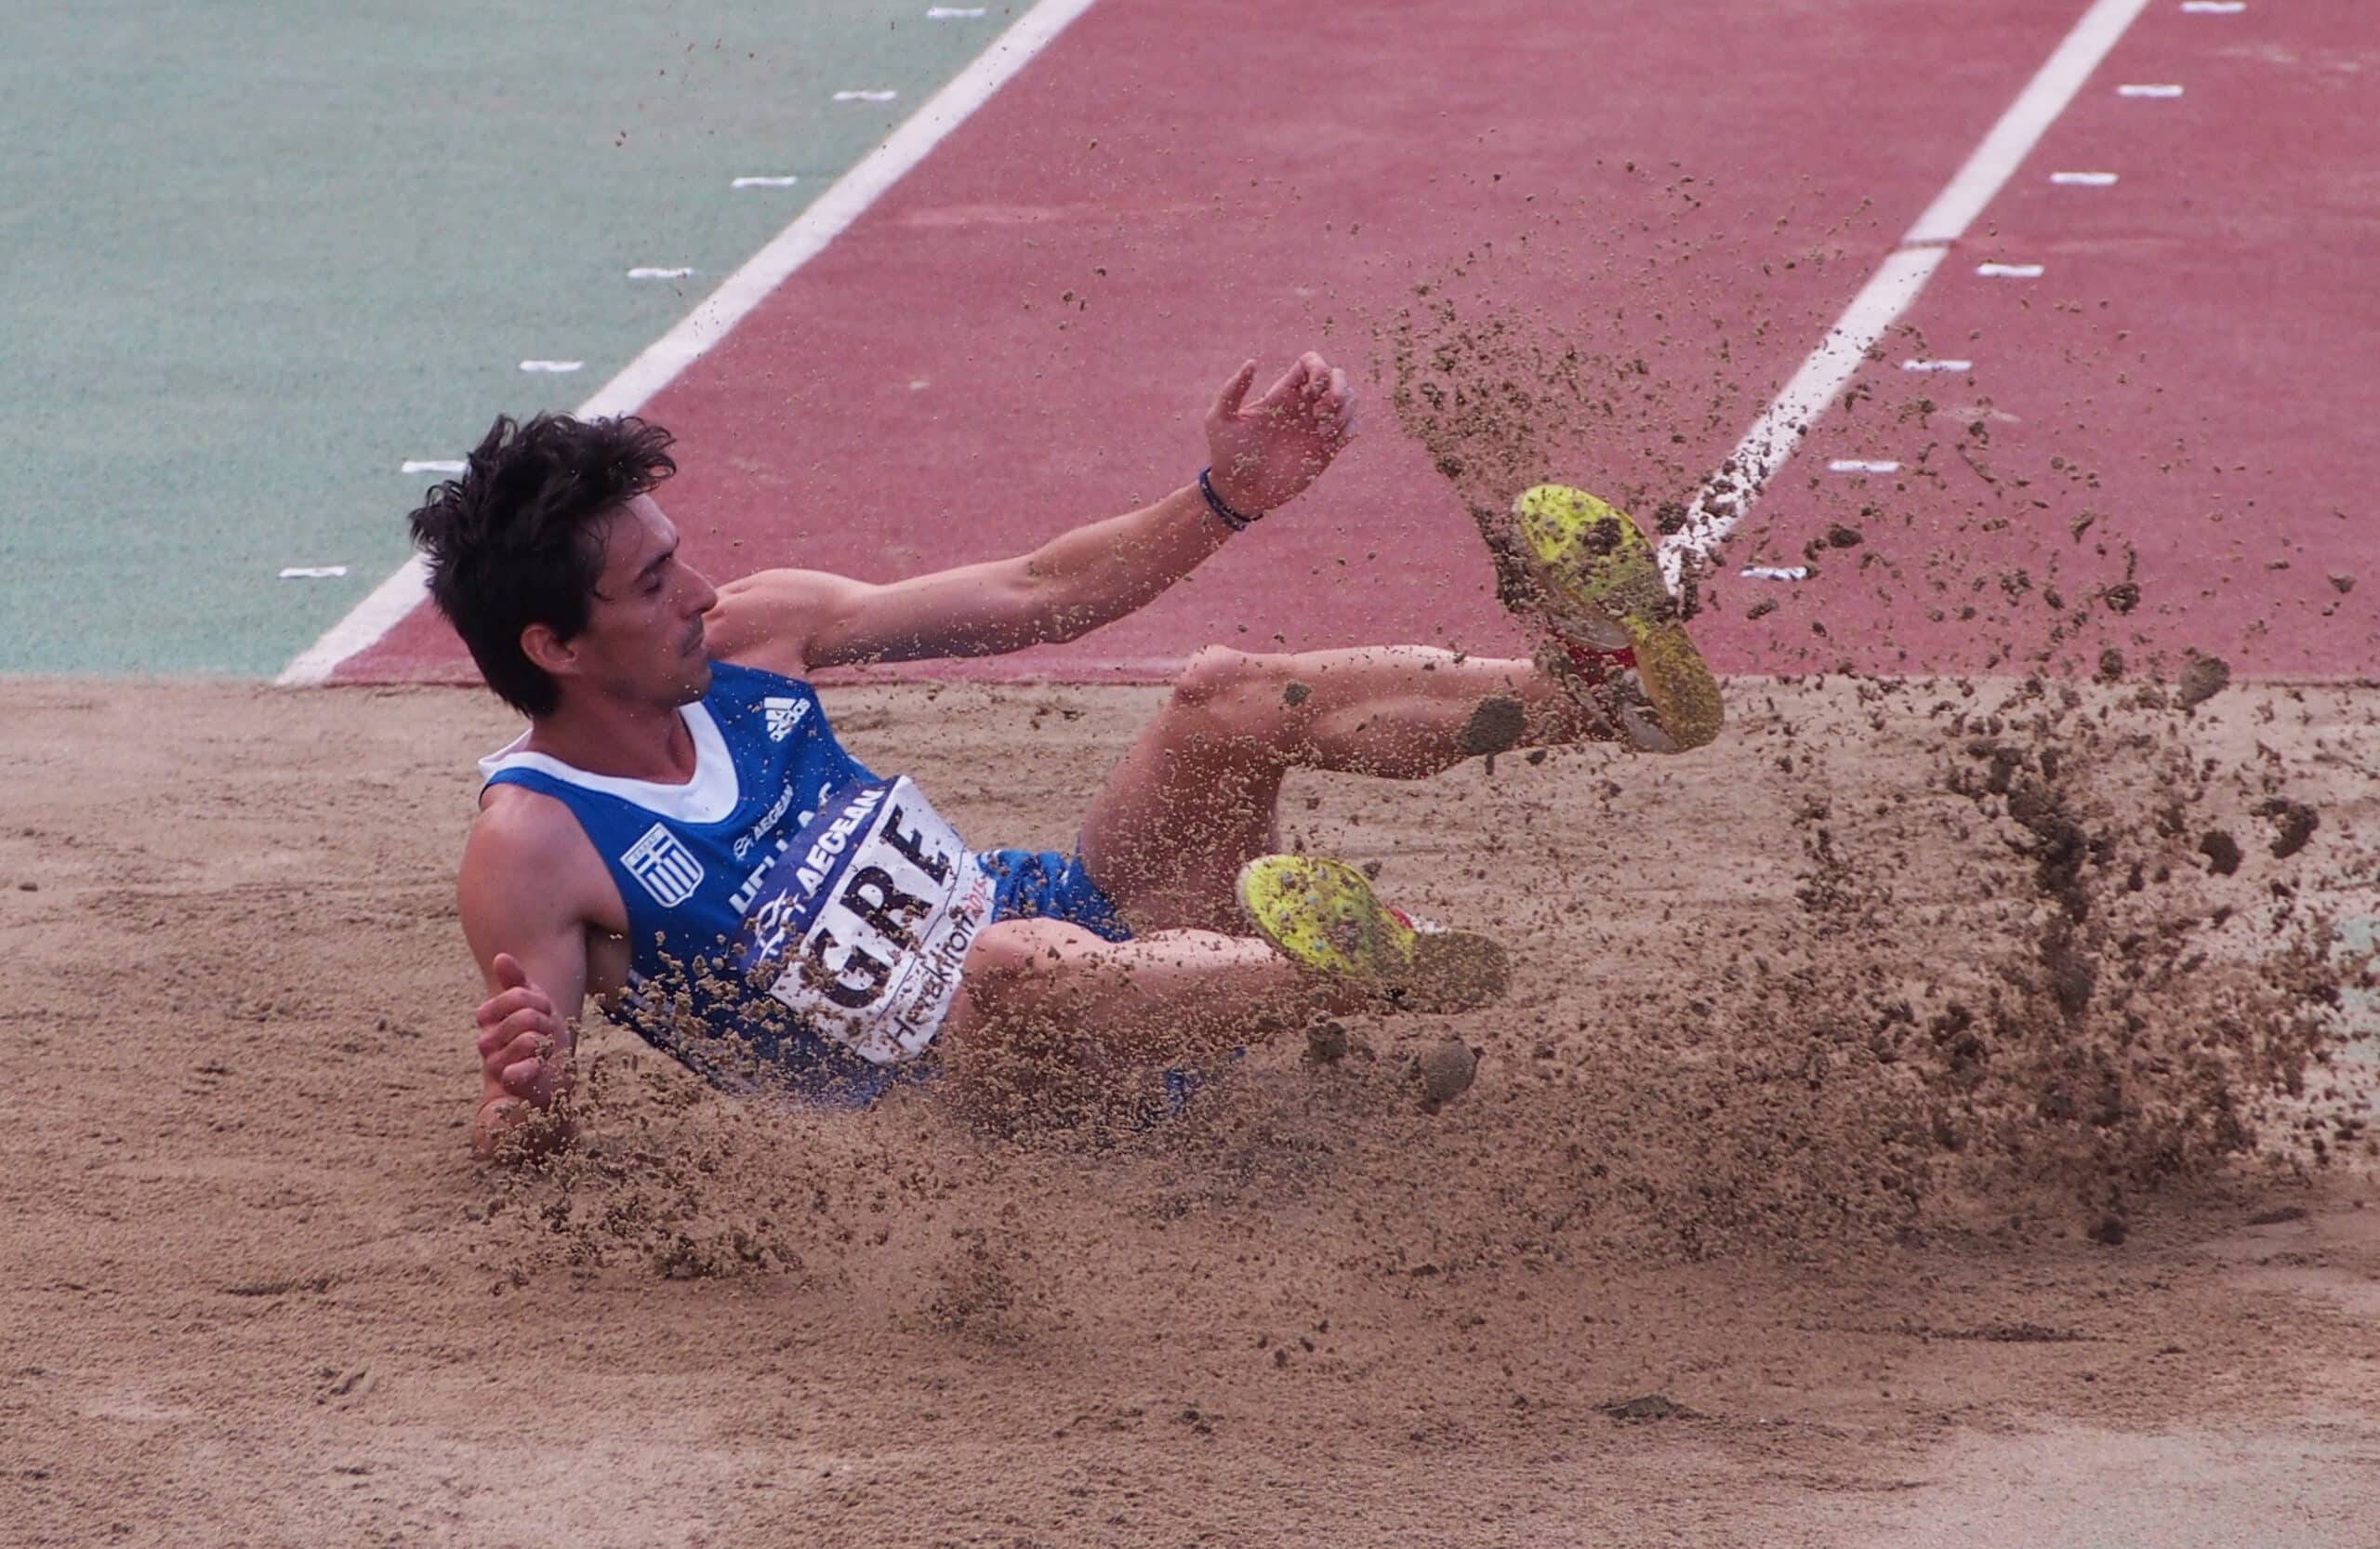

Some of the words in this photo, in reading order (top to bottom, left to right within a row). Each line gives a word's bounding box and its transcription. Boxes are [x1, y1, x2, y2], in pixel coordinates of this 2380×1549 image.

[752, 784, 793, 841] AEGEAN
[796, 789, 885, 899] AEGEAN
[810, 803, 950, 1009] GRE
